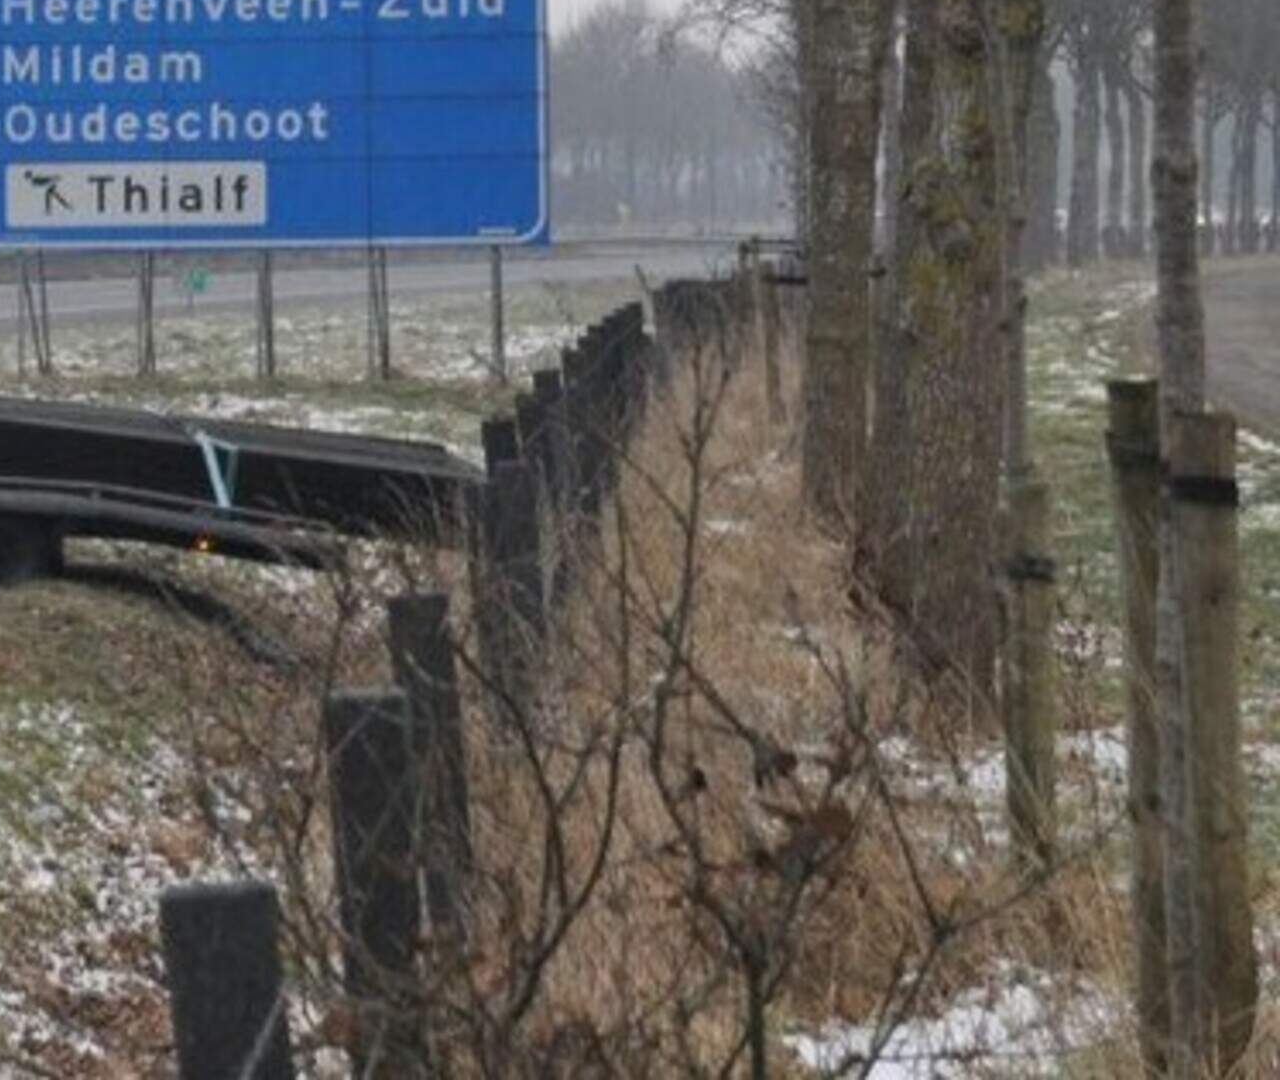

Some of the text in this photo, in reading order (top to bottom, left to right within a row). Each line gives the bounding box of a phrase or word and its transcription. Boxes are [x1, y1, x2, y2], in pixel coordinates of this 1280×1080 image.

[3, 45, 203, 84] Mildam
[4, 102, 329, 144] Oudeschoot
[88, 174, 248, 214] Thialf
